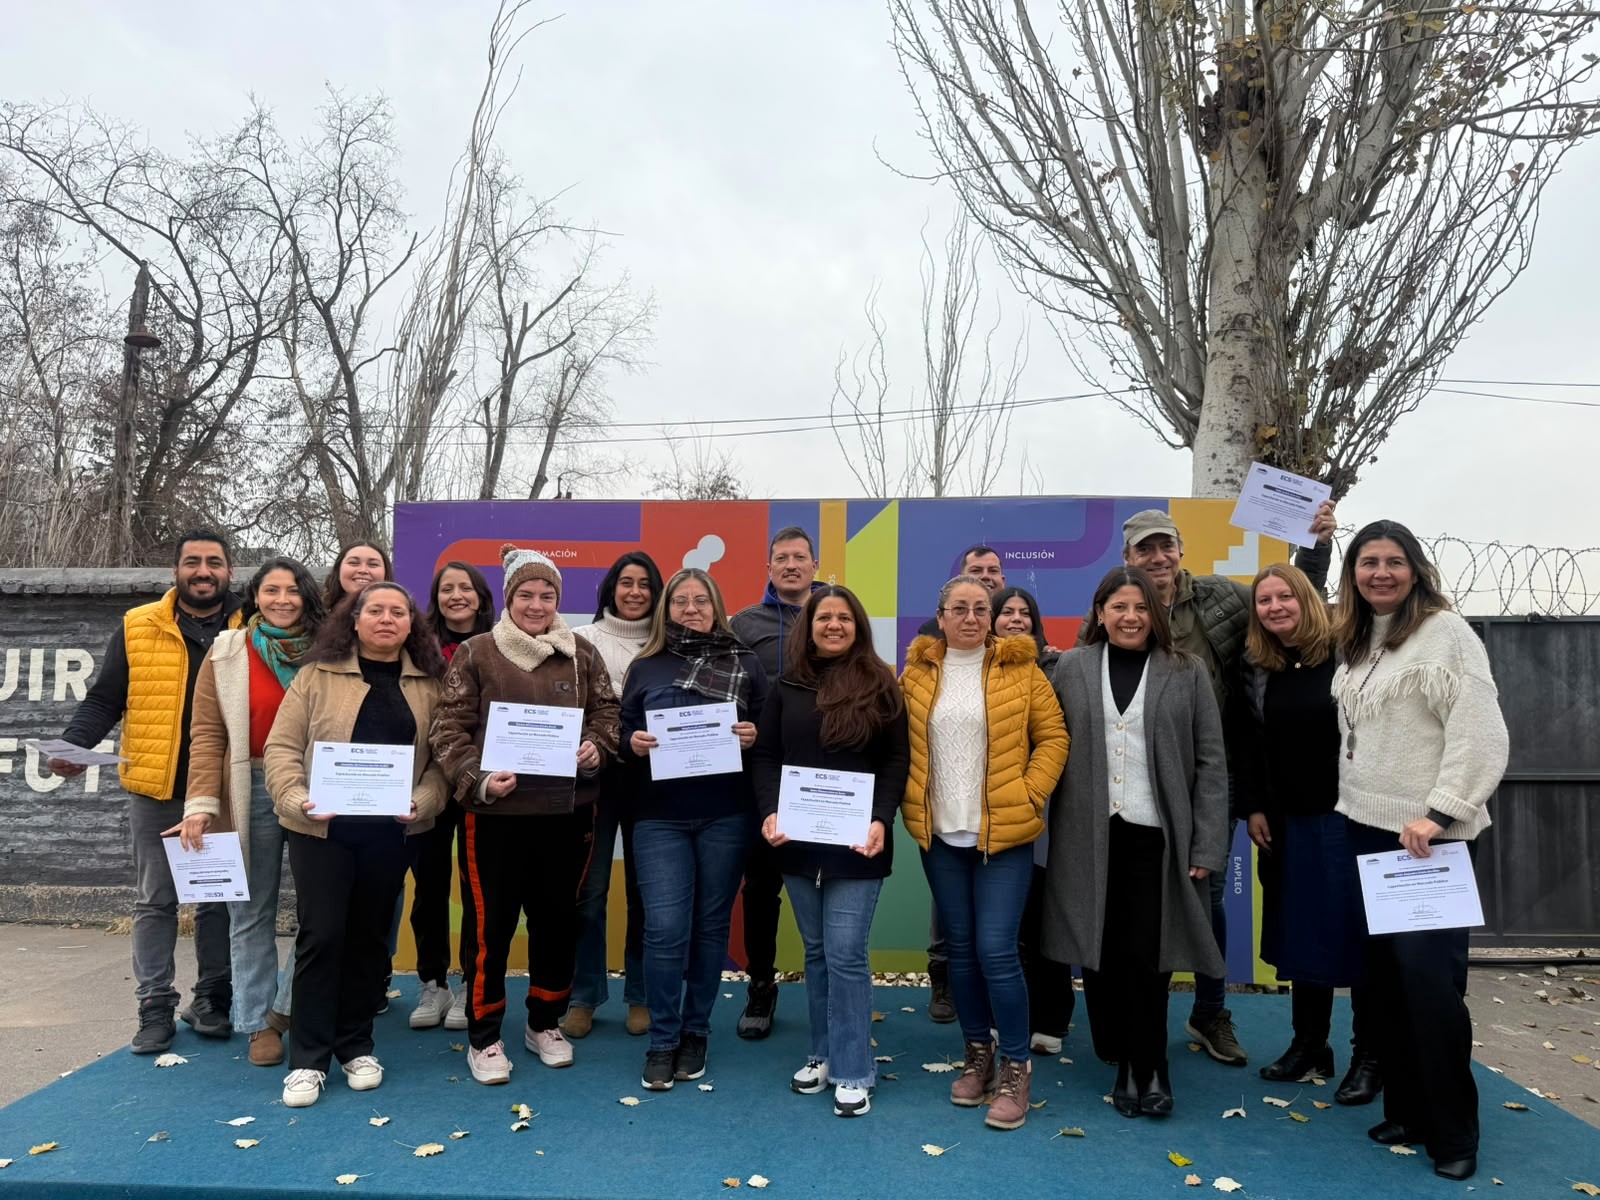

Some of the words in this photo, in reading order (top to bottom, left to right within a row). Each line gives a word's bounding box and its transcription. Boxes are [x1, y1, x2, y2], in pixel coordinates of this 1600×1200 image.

[1280, 475, 1292, 483] ECS
[1005, 549, 1055, 559] INCLUSIÓN
[1397, 854, 1412, 862] ECS
[1234, 857, 1242, 894] EMPLEO
